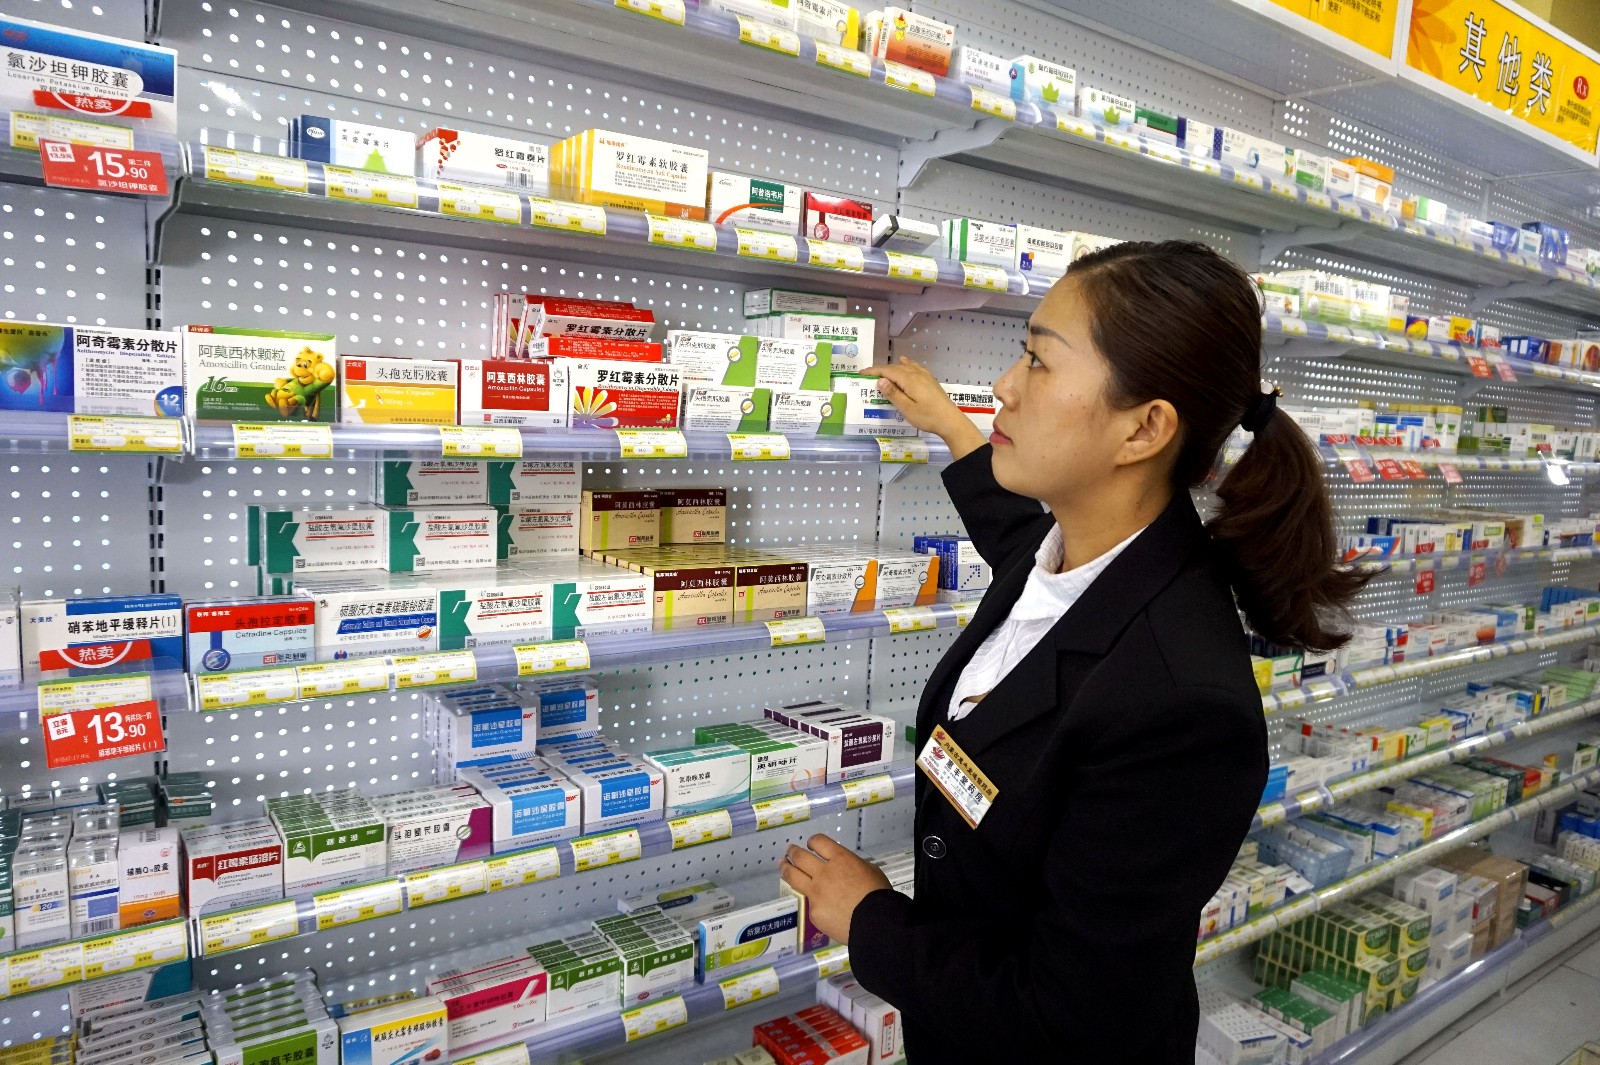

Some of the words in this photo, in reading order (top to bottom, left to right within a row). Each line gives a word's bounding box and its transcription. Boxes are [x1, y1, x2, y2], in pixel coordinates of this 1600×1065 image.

[6, 51, 129, 89] 氯沙坦钾胶囊
[1459, 12, 1553, 114] 其他类
[50, 78, 91, 92] Potassium
[94, 86, 129, 98] Capsules
[1576, 77, 1589, 99] Rx
[75, 96, 113, 111] 热卖
[494, 147, 546, 164] 罗红霉素片
[616, 150, 690, 174] 罗红霉素软胶囊
[87, 151, 148, 179] 15.90
[97, 178, 158, 192] 氯沙坦钾胶囊
[565, 322, 648, 338] 罗红霉素分散片
[802, 323, 859, 336] 阿莫西林胶囊
[76, 334, 178, 354] 阿奇霉素分散片
[198, 344, 286, 362] 阿莫西林颗粒
[199, 358, 246, 370] Amoxicillin
[249, 361, 287, 372] Granules
[376, 367, 448, 382] 头孢克肟胶囊
[487, 371, 546, 387] 阿莫西林胶囊
[596, 369, 680, 387] 罗红霉素分散片
[202, 375, 228, 393] 16
[161, 394, 179, 405] 12
[677, 497, 721, 506] 阿莫西林胶囊
[680, 577, 728, 588] 阿莫西林胶囊
[759, 572, 802, 584] 阿莫西林胶囊
[235, 615, 308, 628] 头孢拉定胶囊
[273, 627, 307, 637] Capsules
[79, 645, 114, 662] 热卖
[53, 718, 69, 728] 立省
[87, 711, 146, 745] 13.90
[217, 851, 279, 871] 红霉素肠溶片
